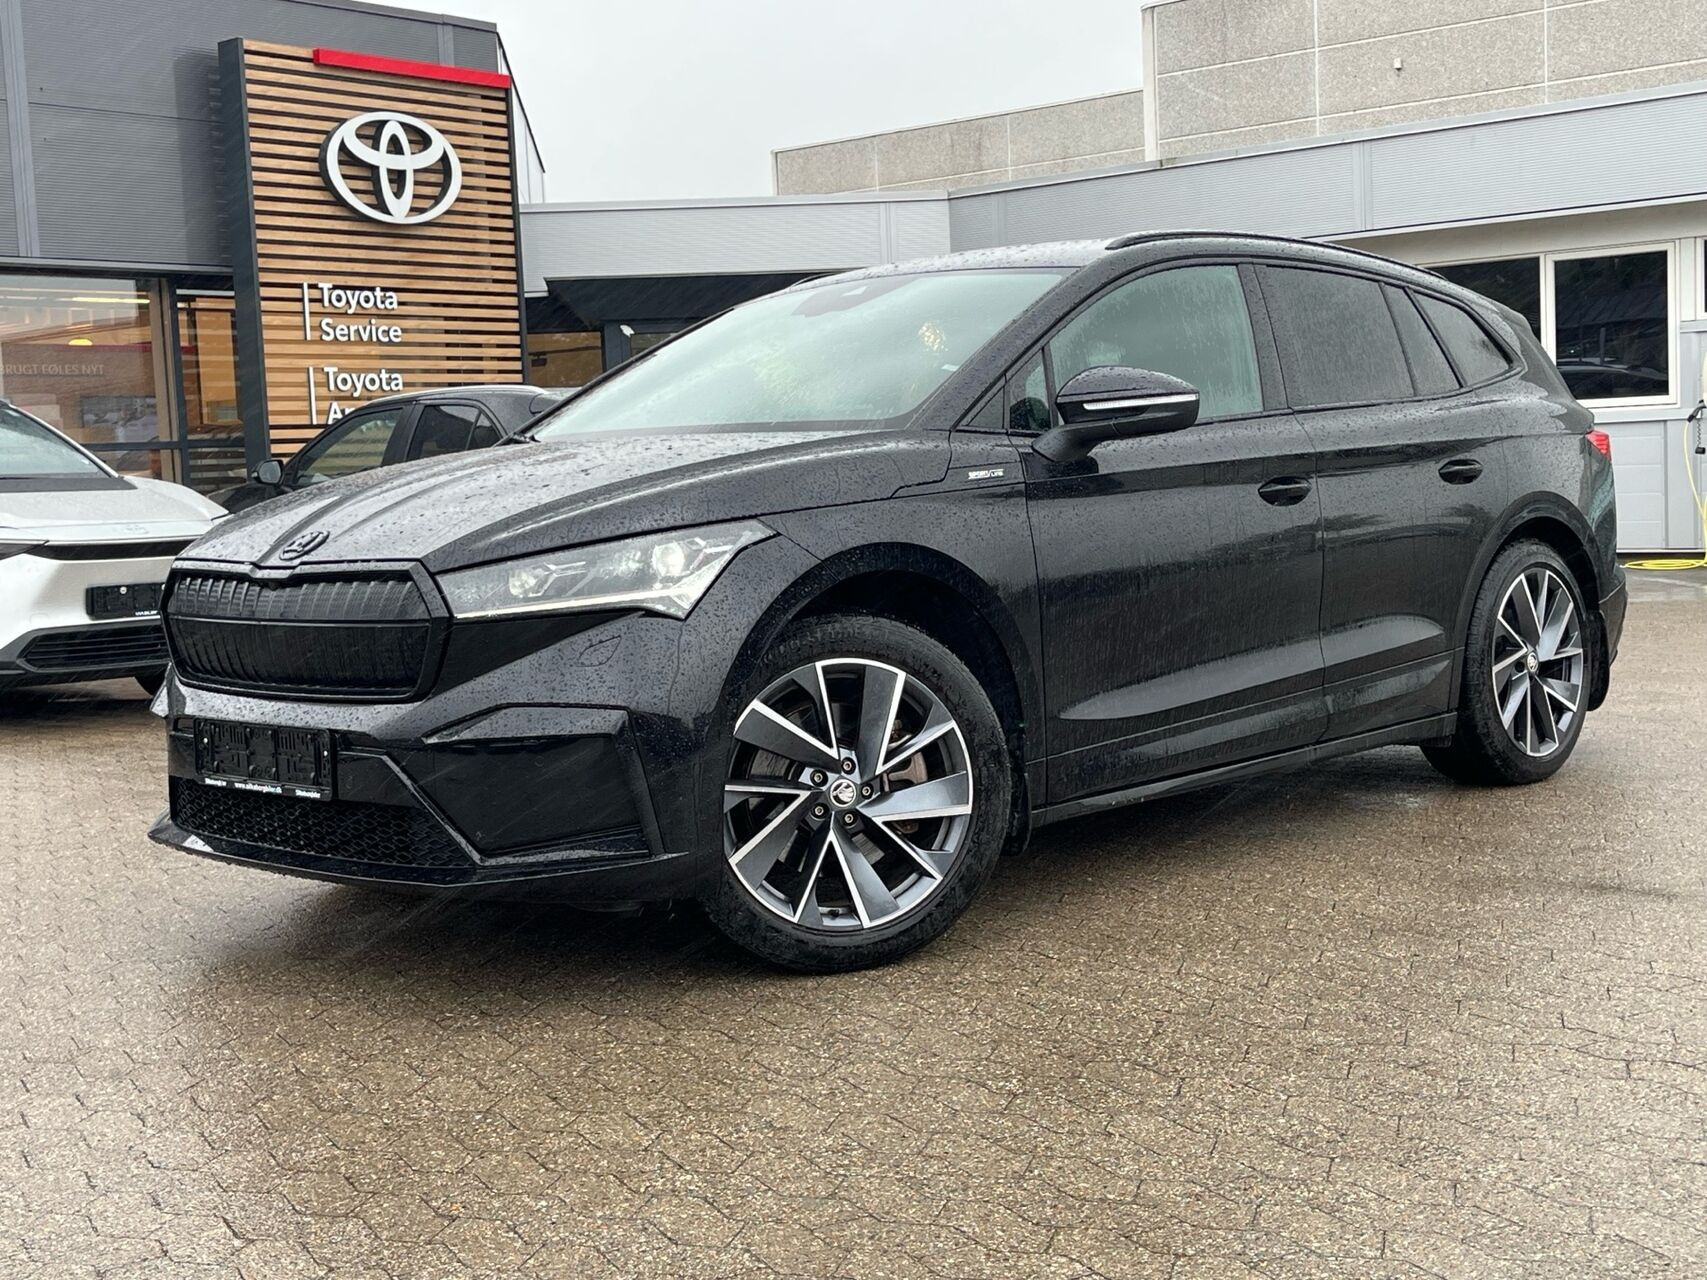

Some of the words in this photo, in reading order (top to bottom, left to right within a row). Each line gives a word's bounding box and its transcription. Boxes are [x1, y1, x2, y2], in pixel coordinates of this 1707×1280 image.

[318, 283, 398, 314] Toyota
[321, 318, 402, 342] Service
[81, 364, 104, 375] NYT
[324, 367, 403, 397] Toyota
